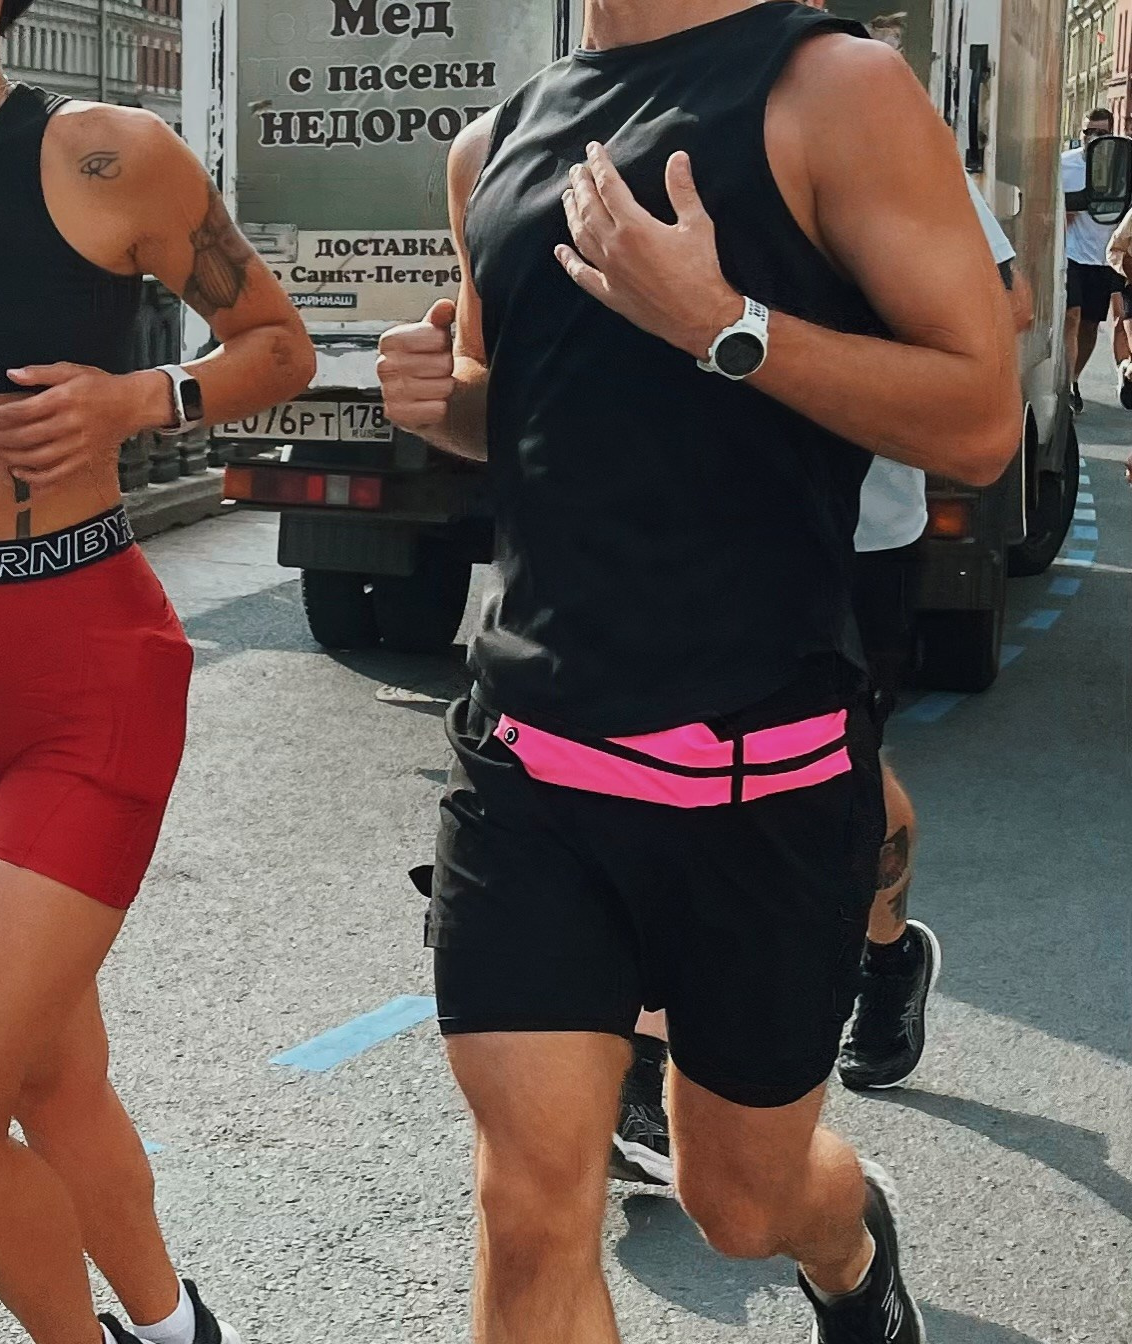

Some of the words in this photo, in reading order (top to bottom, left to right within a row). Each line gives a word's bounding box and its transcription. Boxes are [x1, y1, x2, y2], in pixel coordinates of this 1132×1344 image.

[288, 67, 312, 93] с
[327, 61, 496, 91] пасеки
[315, 238, 458, 258] ДОСТАВКА
[343, 405, 385, 428] 178
